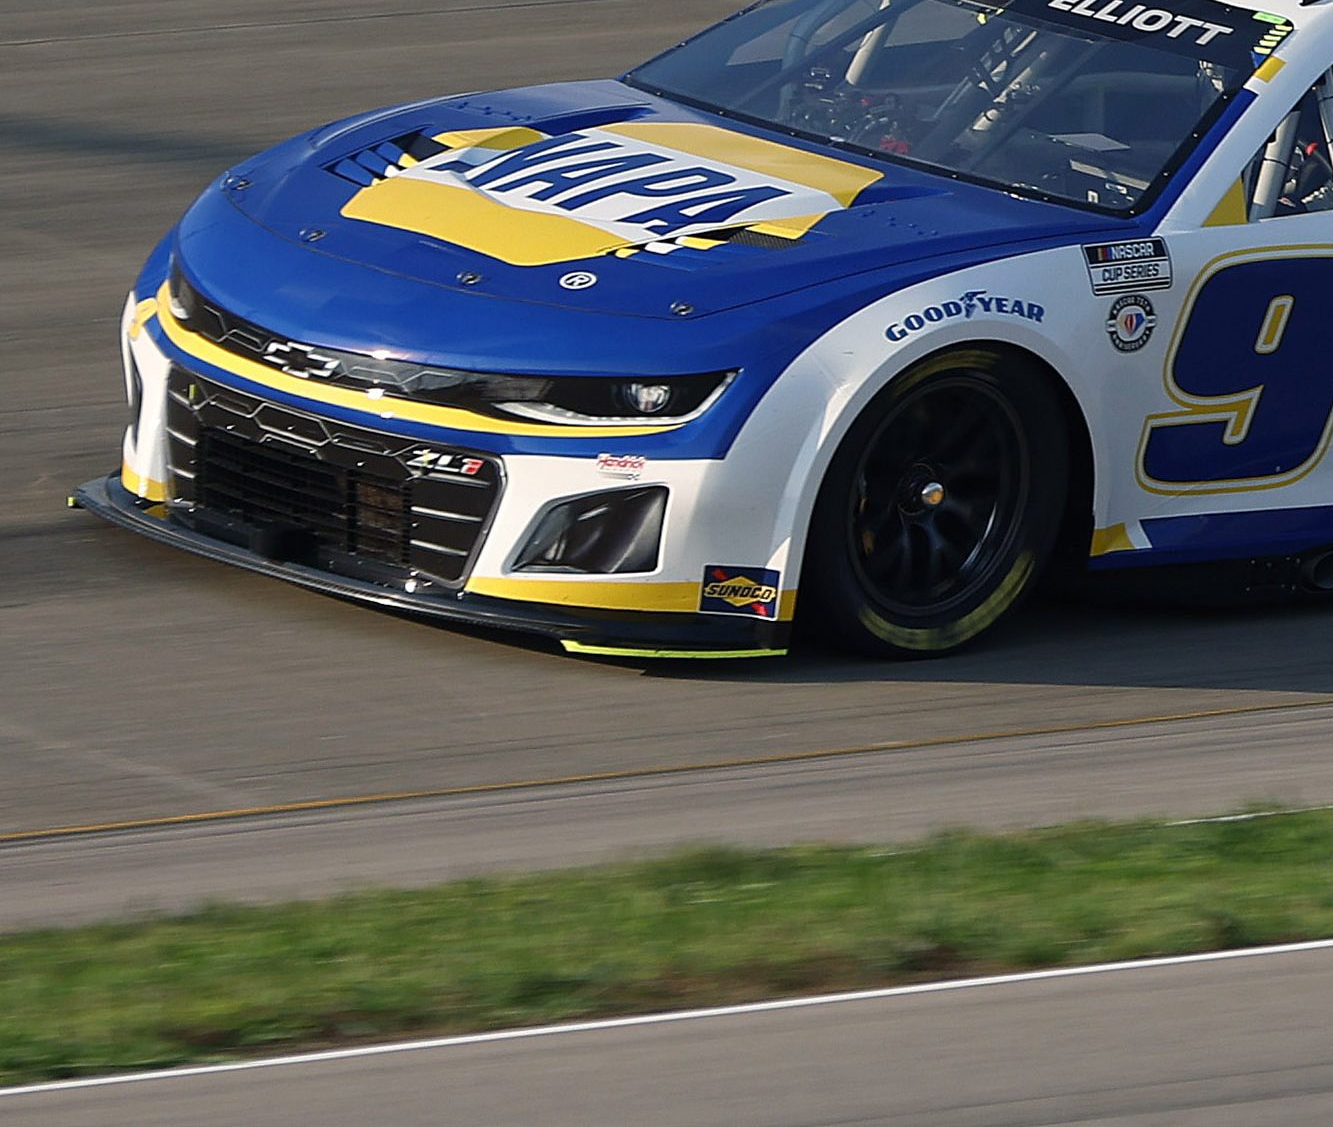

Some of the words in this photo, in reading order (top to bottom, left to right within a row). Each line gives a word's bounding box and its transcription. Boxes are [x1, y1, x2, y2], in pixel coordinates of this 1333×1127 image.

[427, 132, 793, 236] NAPA
[1112, 242, 1154, 260] NASCAR
[1102, 267, 1122, 281] CUP
[1124, 263, 1160, 279] SERIES
[885, 291, 1045, 342] GOODYEAR
[705, 584, 774, 600] SUNOCO
